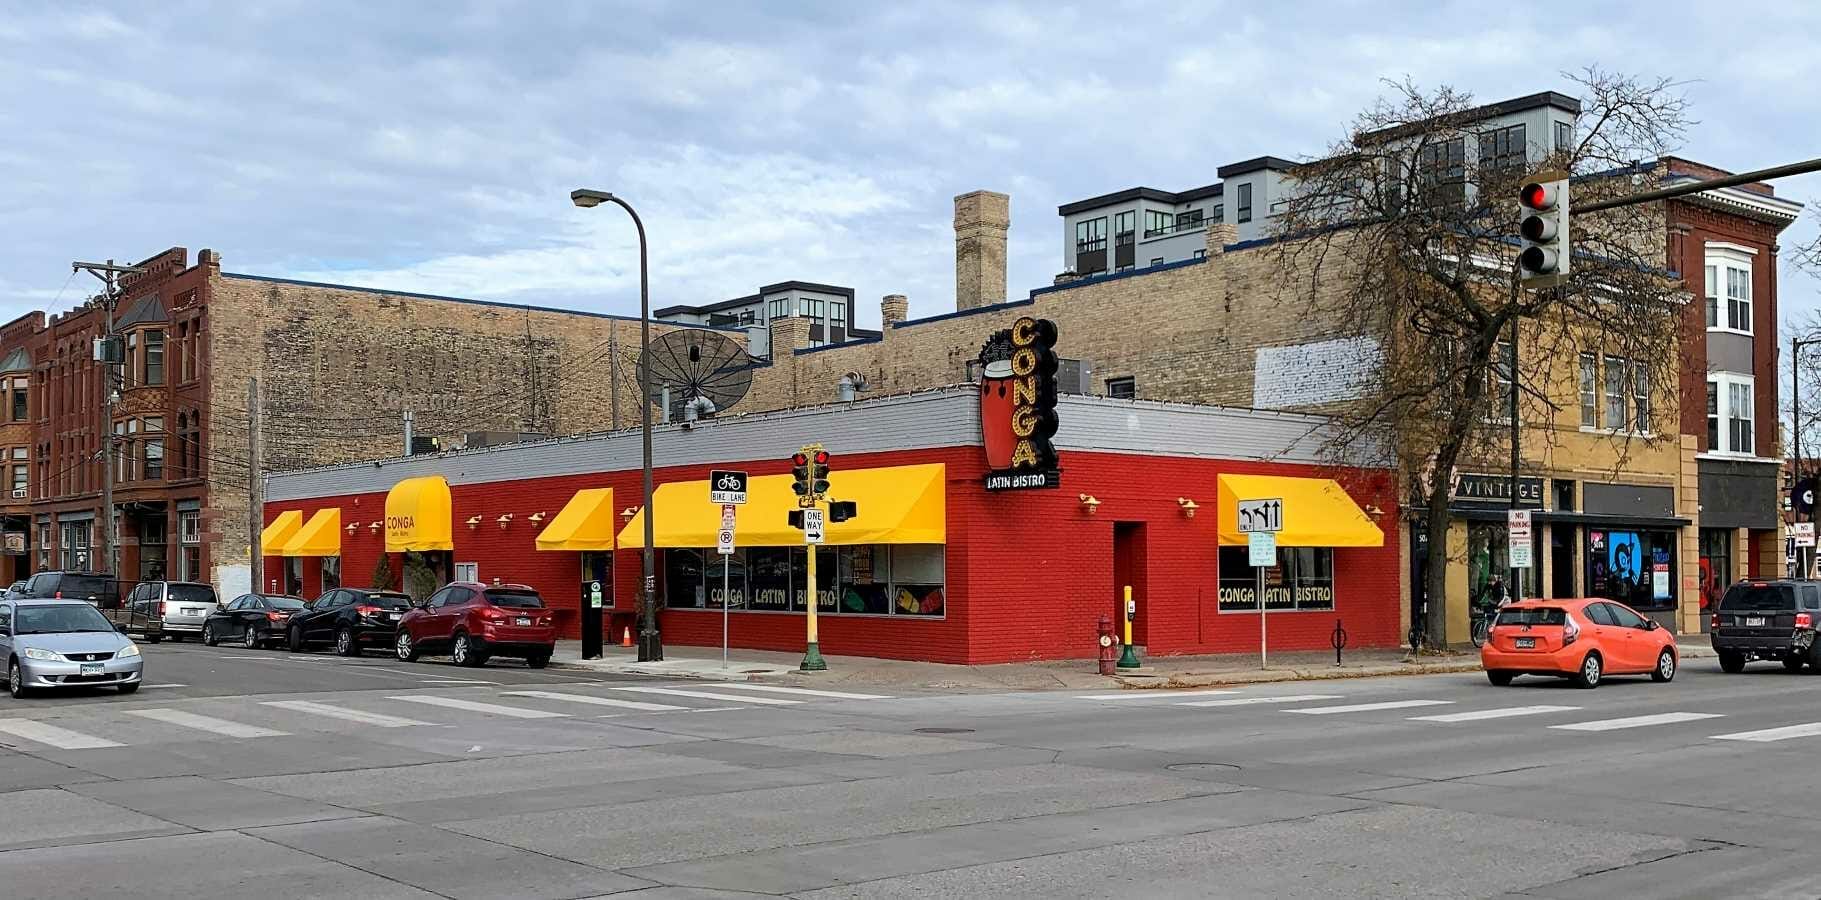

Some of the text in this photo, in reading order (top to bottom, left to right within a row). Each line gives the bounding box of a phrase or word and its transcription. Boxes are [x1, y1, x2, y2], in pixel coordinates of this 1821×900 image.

[1012, 318, 1037, 468] CONGA
[987, 473, 1045, 489] LATIN BISTRO
[713, 492, 745, 502] BIKE LANE
[387, 515, 415, 529] CONGA
[808, 512, 822, 520] ONE
[807, 521, 822, 529] WAY
[755, 588, 786, 604] LATIN
[796, 590, 835, 606] BITRO
[1218, 587, 1255, 603] CONGA
[1296, 586, 1331, 602] BISTRO
